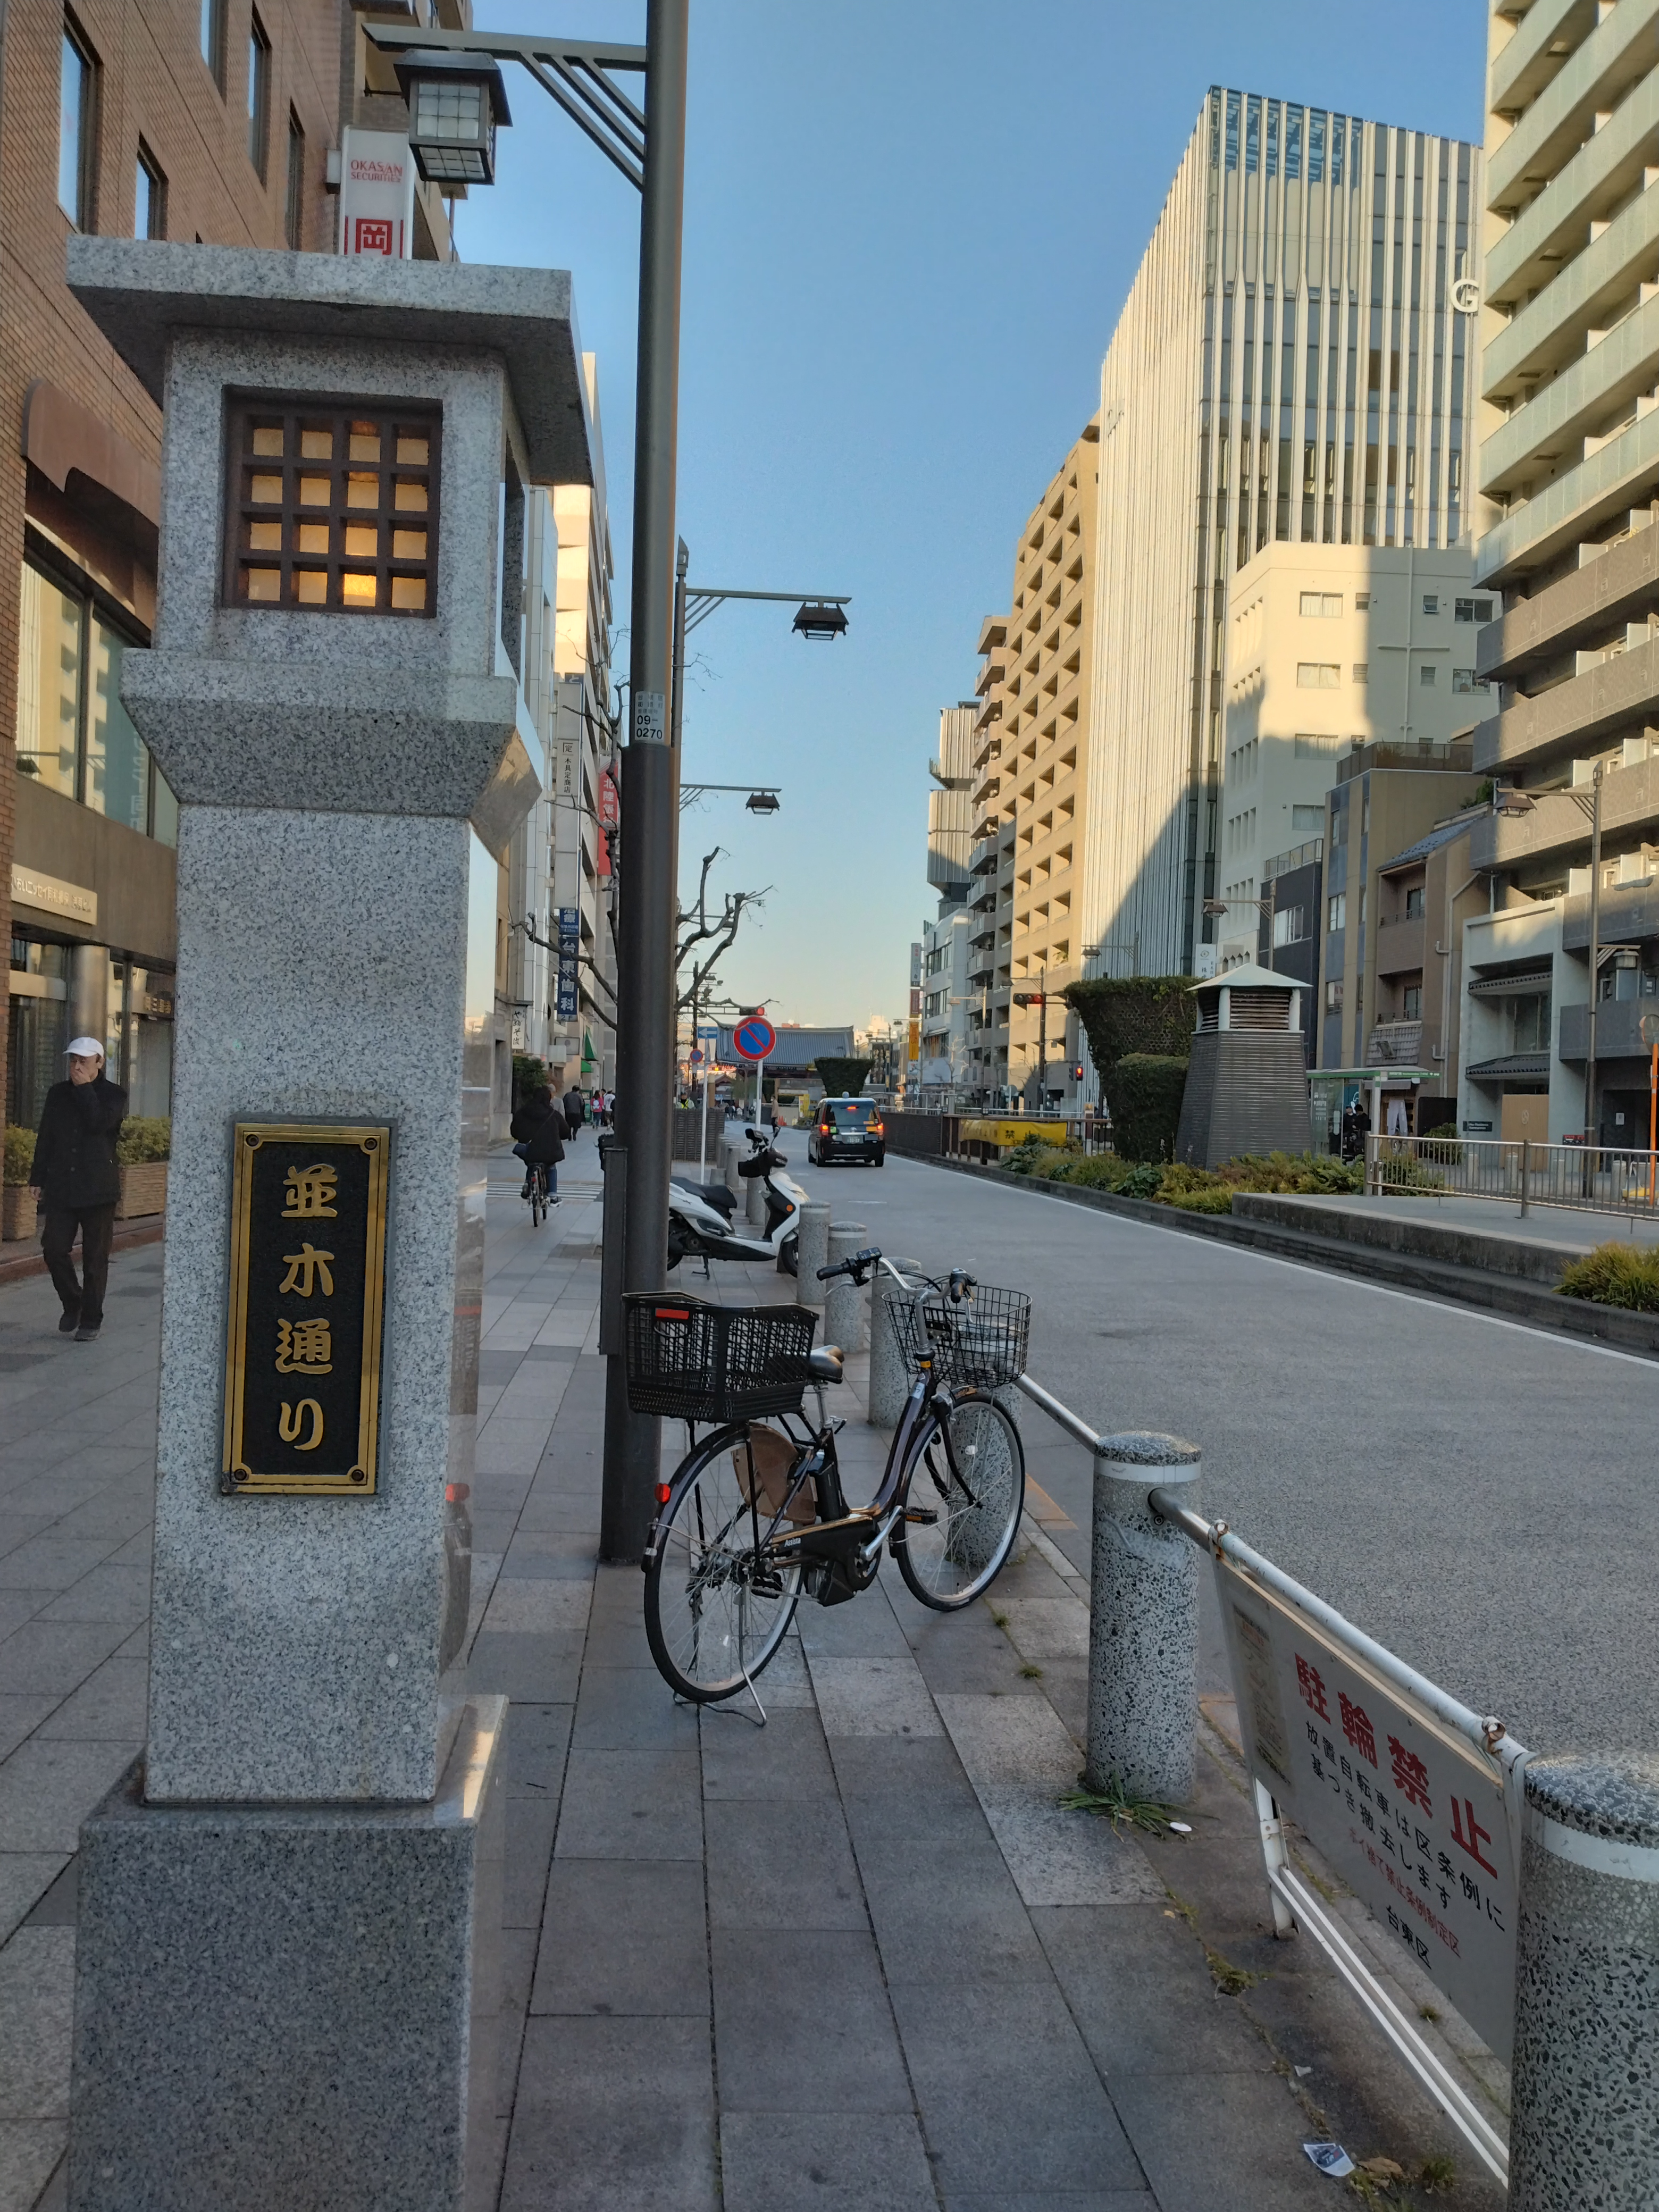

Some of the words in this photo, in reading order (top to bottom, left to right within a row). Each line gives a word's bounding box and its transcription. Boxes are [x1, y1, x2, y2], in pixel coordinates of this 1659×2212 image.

[350, 160, 403, 177] OKASAN
[350, 172, 401, 183] SECURITIES
[636, 728, 663, 739] 0270
[784, 1537, 801, 1547] Assista
[1295, 1652, 1497, 1880] 駐輪禁止
[1305, 1720, 1505, 1932] 放置自転車は区条例に
[1386, 1905, 1432, 1970] 台東区
